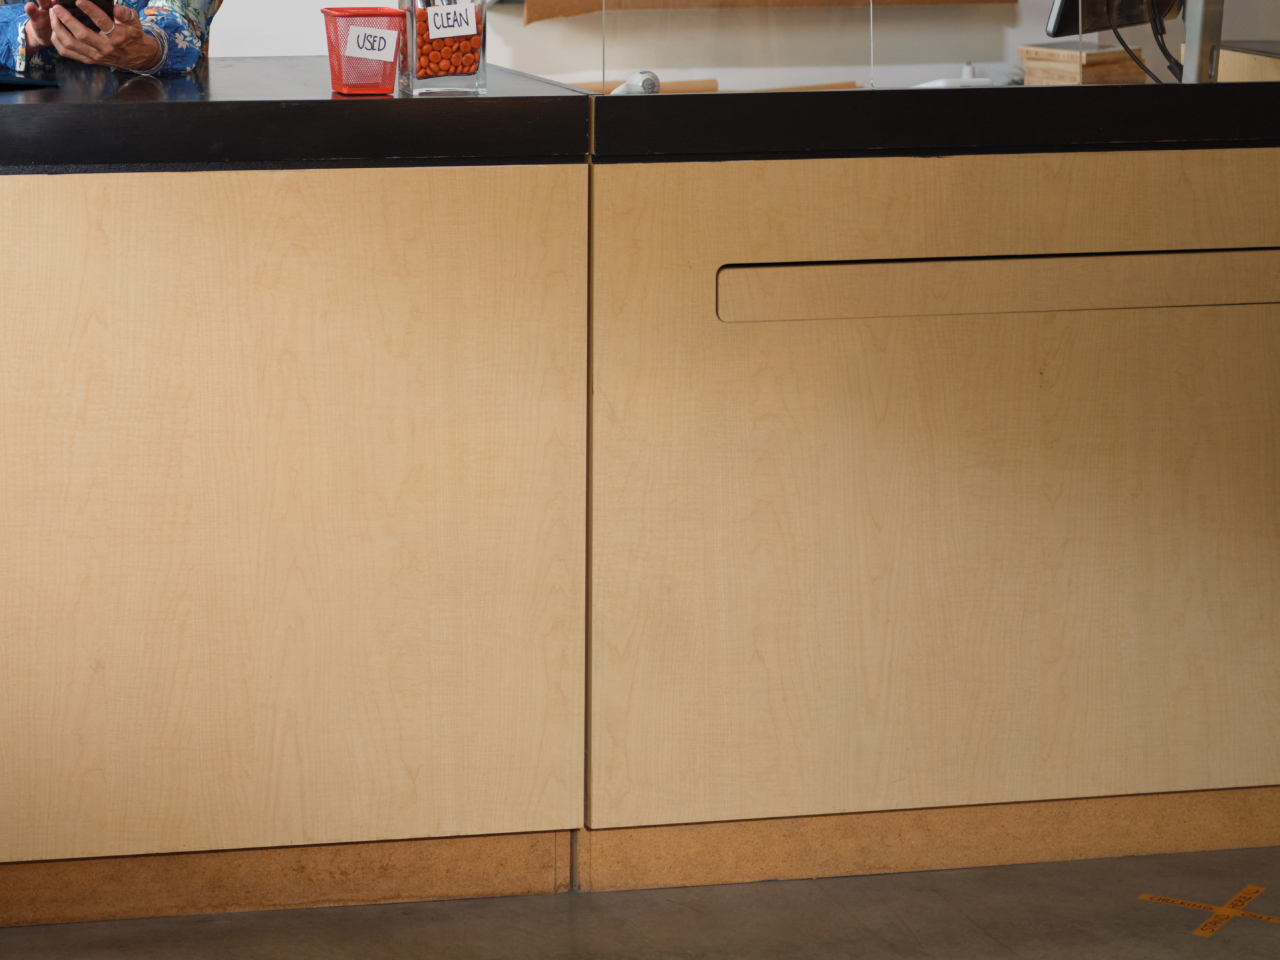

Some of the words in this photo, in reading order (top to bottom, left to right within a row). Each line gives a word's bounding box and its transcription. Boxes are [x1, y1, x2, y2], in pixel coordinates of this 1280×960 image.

[433, 8, 470, 30] CLEAN
[356, 33, 387, 52] USED
[1149, 896, 1214, 911] CHECKING
[1241, 912, 1275, 921] OUT
[1200, 914, 1230, 933] STAND
[1227, 895, 1252, 910] HERE
